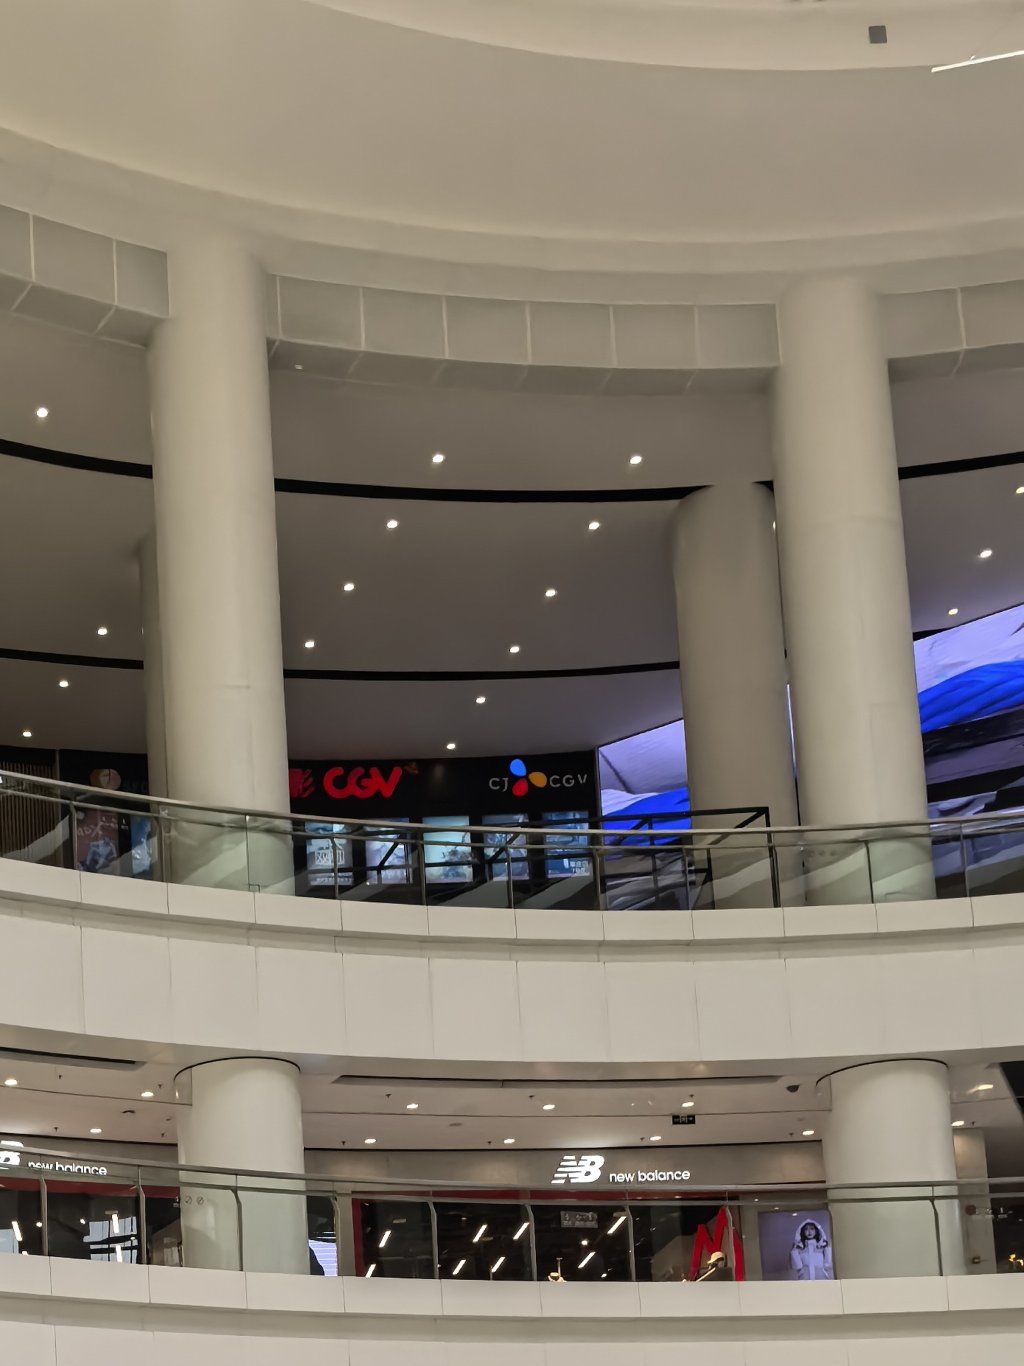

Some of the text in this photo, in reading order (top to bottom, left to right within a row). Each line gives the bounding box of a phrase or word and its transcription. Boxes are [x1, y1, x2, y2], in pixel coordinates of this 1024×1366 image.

[323, 766, 403, 799] CGV
[489, 774, 588, 792] CJ CGV
[551, 1155, 691, 1184] NB new balance
